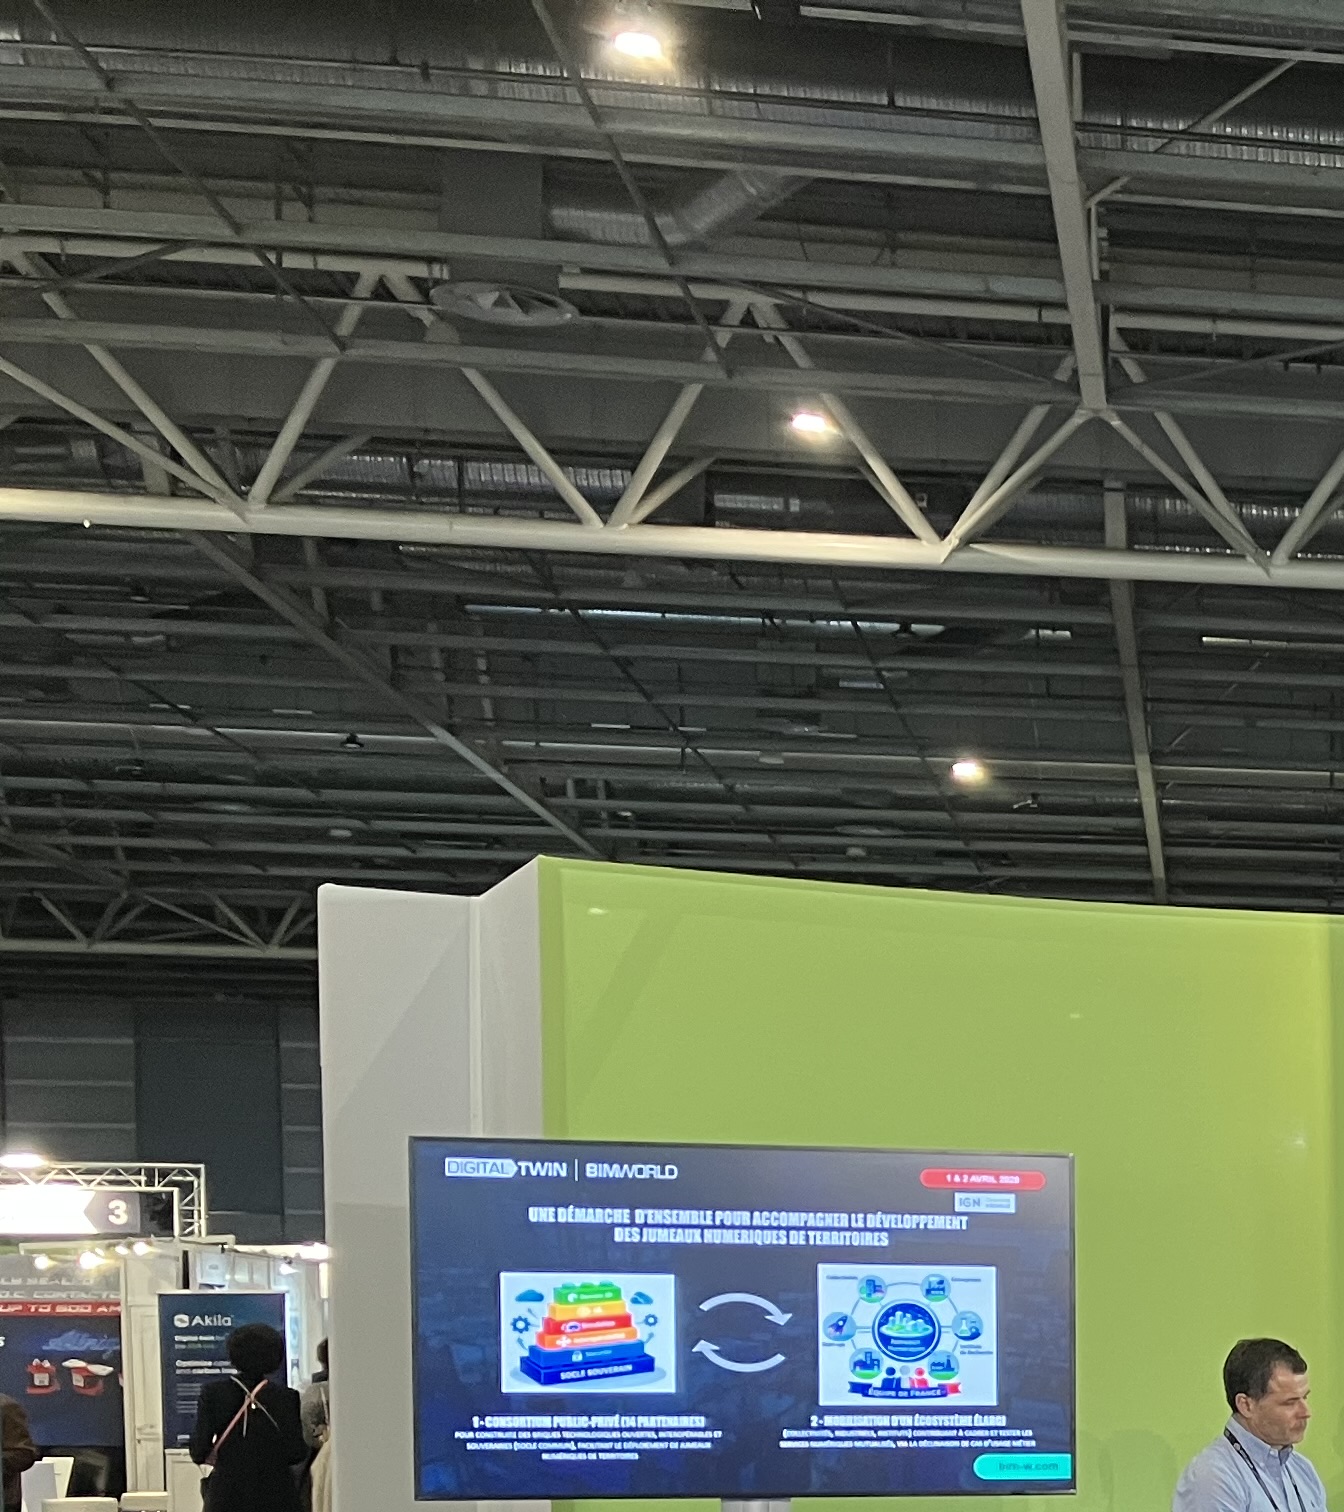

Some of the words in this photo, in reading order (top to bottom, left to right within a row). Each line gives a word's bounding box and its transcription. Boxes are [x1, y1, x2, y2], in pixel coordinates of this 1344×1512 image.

[447, 1160, 510, 1175] DIGITAL
[517, 1161, 567, 1177] TWIN
[585, 1162, 678, 1179] BIMWORLD
[959, 1197, 981, 1208] IGN
[108, 1200, 129, 1225] 3
[528, 1206, 556, 1223] UNE
[557, 1204, 630, 1224] DÉMARCHE
[634, 1208, 713, 1225] D'ENSEMBLE
[715, 1210, 750, 1227] POUR
[752, 1211, 849, 1228] ACCOMPAGNER
[851, 1213, 864, 1228] LE
[866, 1212, 968, 1230] DÉVELOPPEMENT
[614, 1226, 640, 1243] DES
[642, 1227, 702, 1243] JUMEAUX
[789, 1231, 807, 1245] DE
[807, 1231, 889, 1247] TERRITOIRES
[27, 1304, 52, 1313] TO
[96, 1304, 121, 1313] AM
[191, 1314, 232, 1327] Akila
